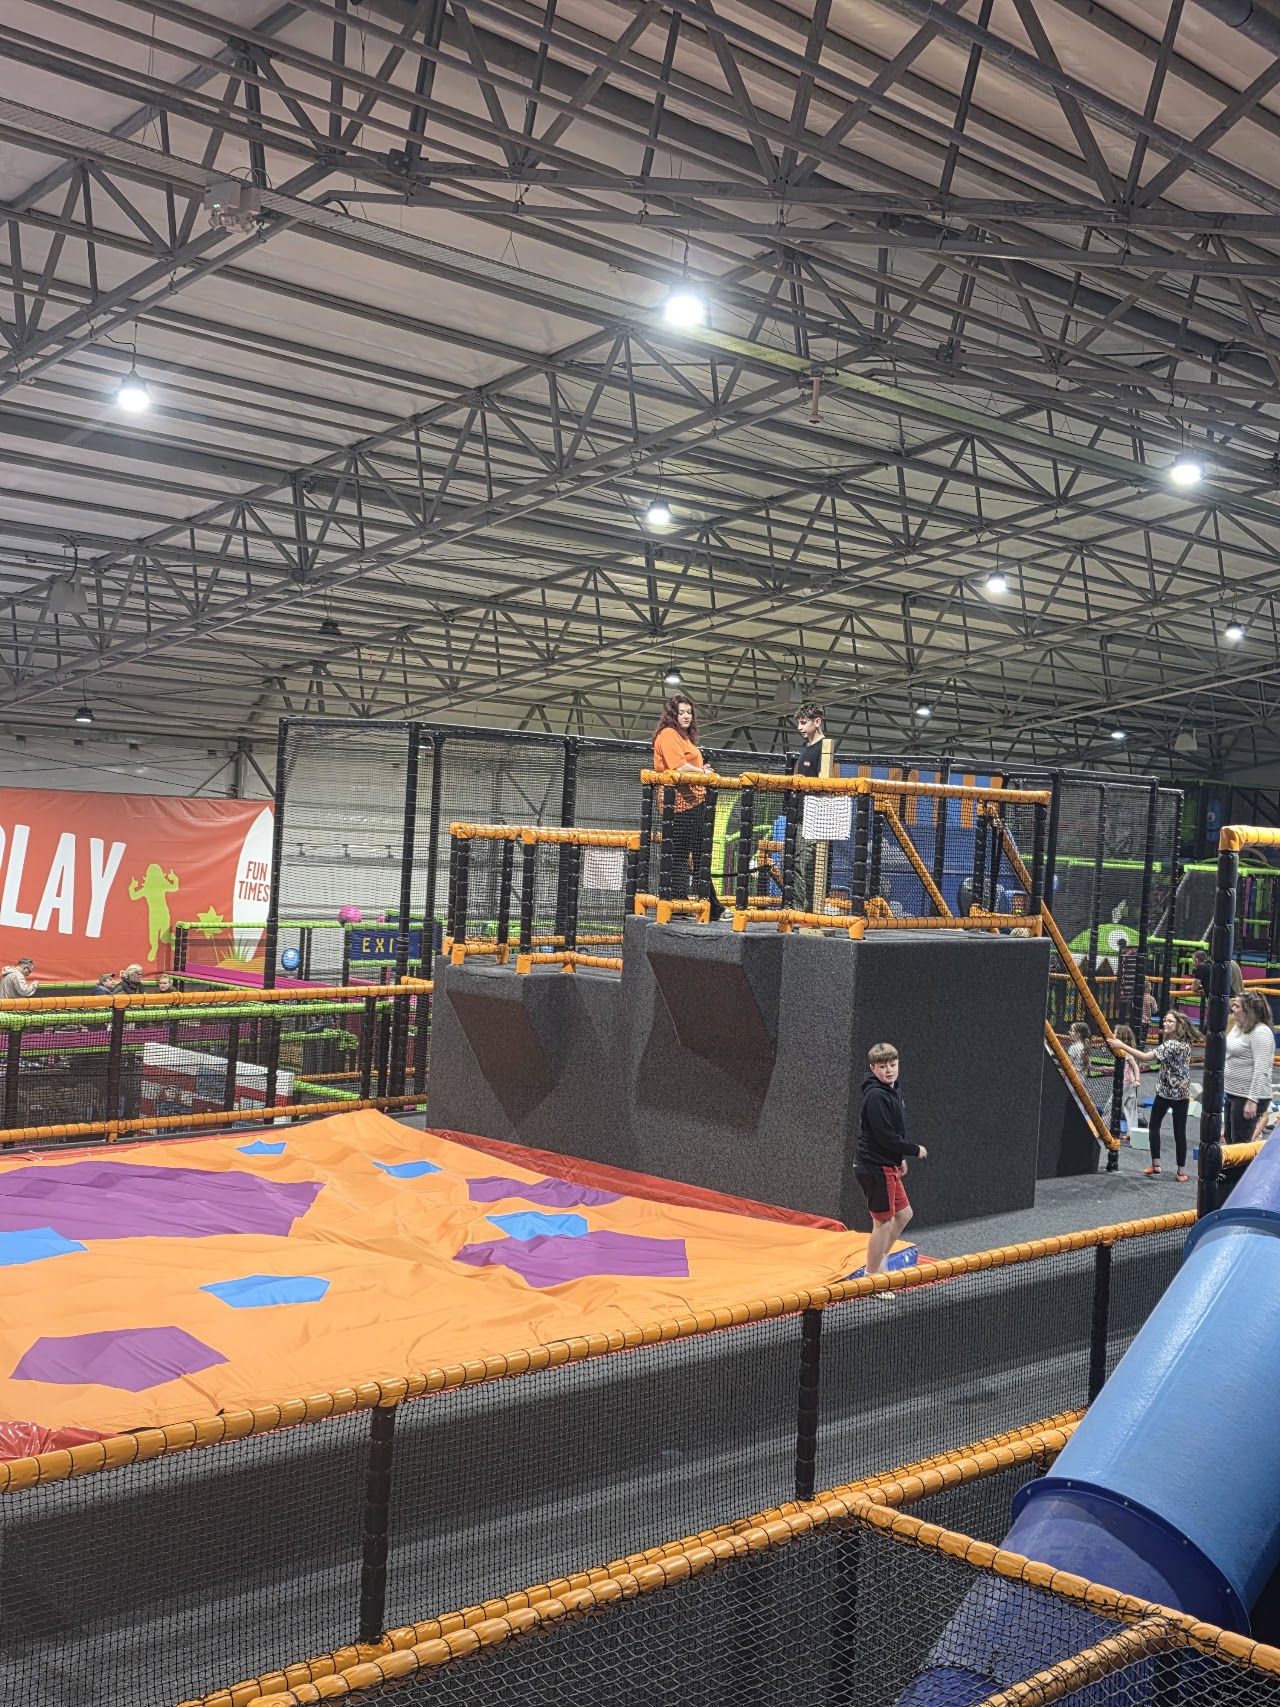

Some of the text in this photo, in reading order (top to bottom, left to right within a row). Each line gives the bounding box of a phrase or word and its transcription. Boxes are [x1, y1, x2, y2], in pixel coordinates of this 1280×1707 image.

[0, 824, 126, 938] LAY
[246, 860, 268, 881] FUN
[238, 880, 271, 902] TIMES
[362, 937, 395, 953] EXI
